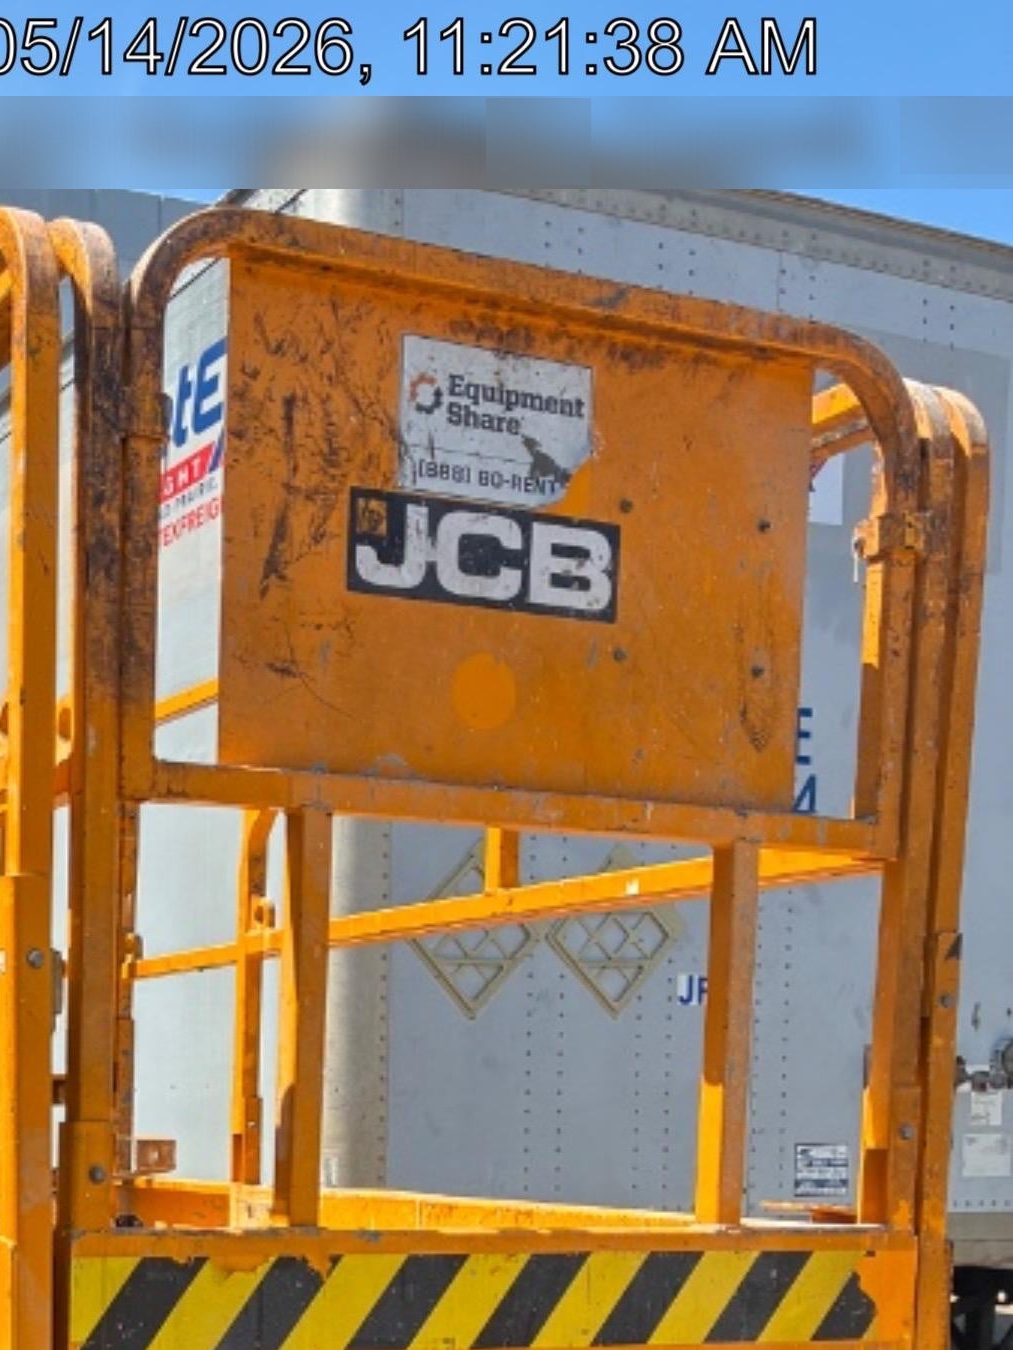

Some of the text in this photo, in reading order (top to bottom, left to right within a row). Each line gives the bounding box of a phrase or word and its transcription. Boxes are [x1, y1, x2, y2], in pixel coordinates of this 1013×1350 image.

[446, 401, 521, 436] Share
[447, 374, 586, 419] Equipment
[354, 502, 614, 611] JCB
